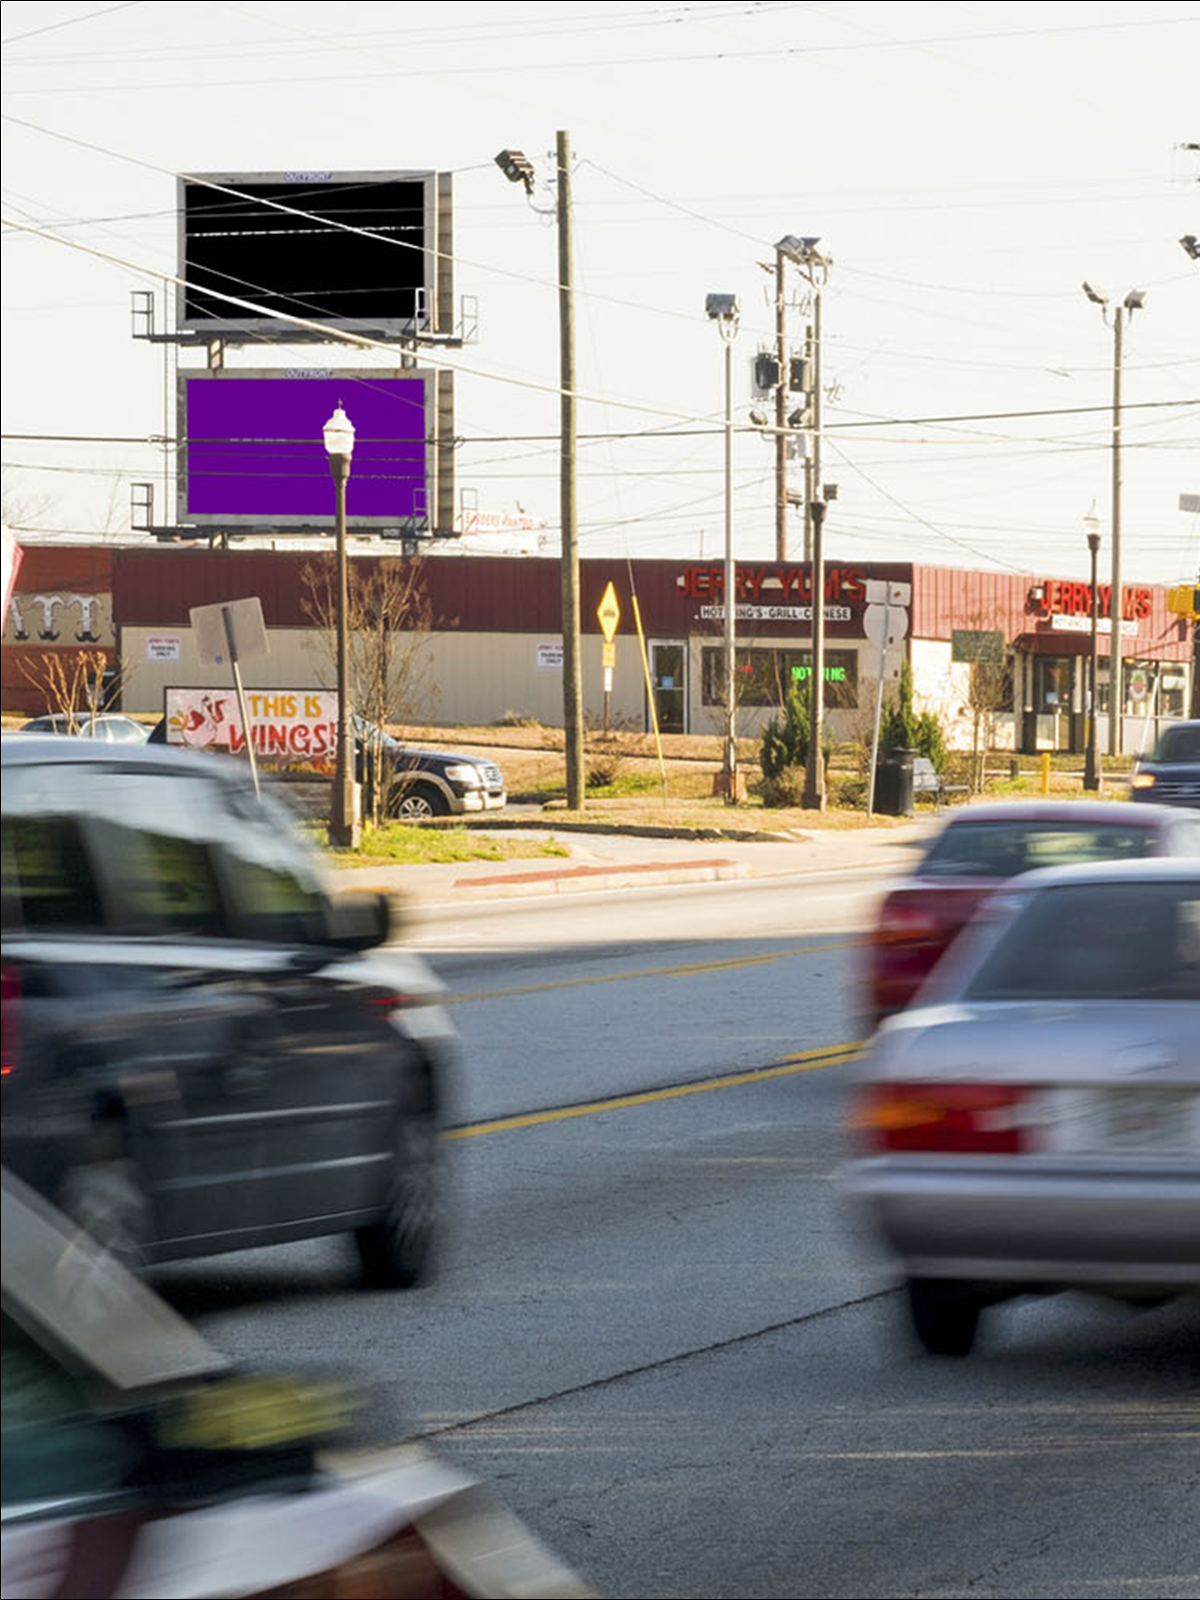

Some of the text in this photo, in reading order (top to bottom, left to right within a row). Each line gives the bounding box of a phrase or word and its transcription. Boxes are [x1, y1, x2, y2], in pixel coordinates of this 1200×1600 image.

[676, 567, 867, 601] JERRY YUM'S
[703, 607, 725, 618] HOT
[769, 609, 799, 620] GRILL
[803, 609, 849, 620] CNESE
[1099, 584, 1152, 620] YM'S
[792, 666, 812, 680] HOT
[249, 695, 322, 717] THIS IS
[229, 721, 338, 756] WINGS!
